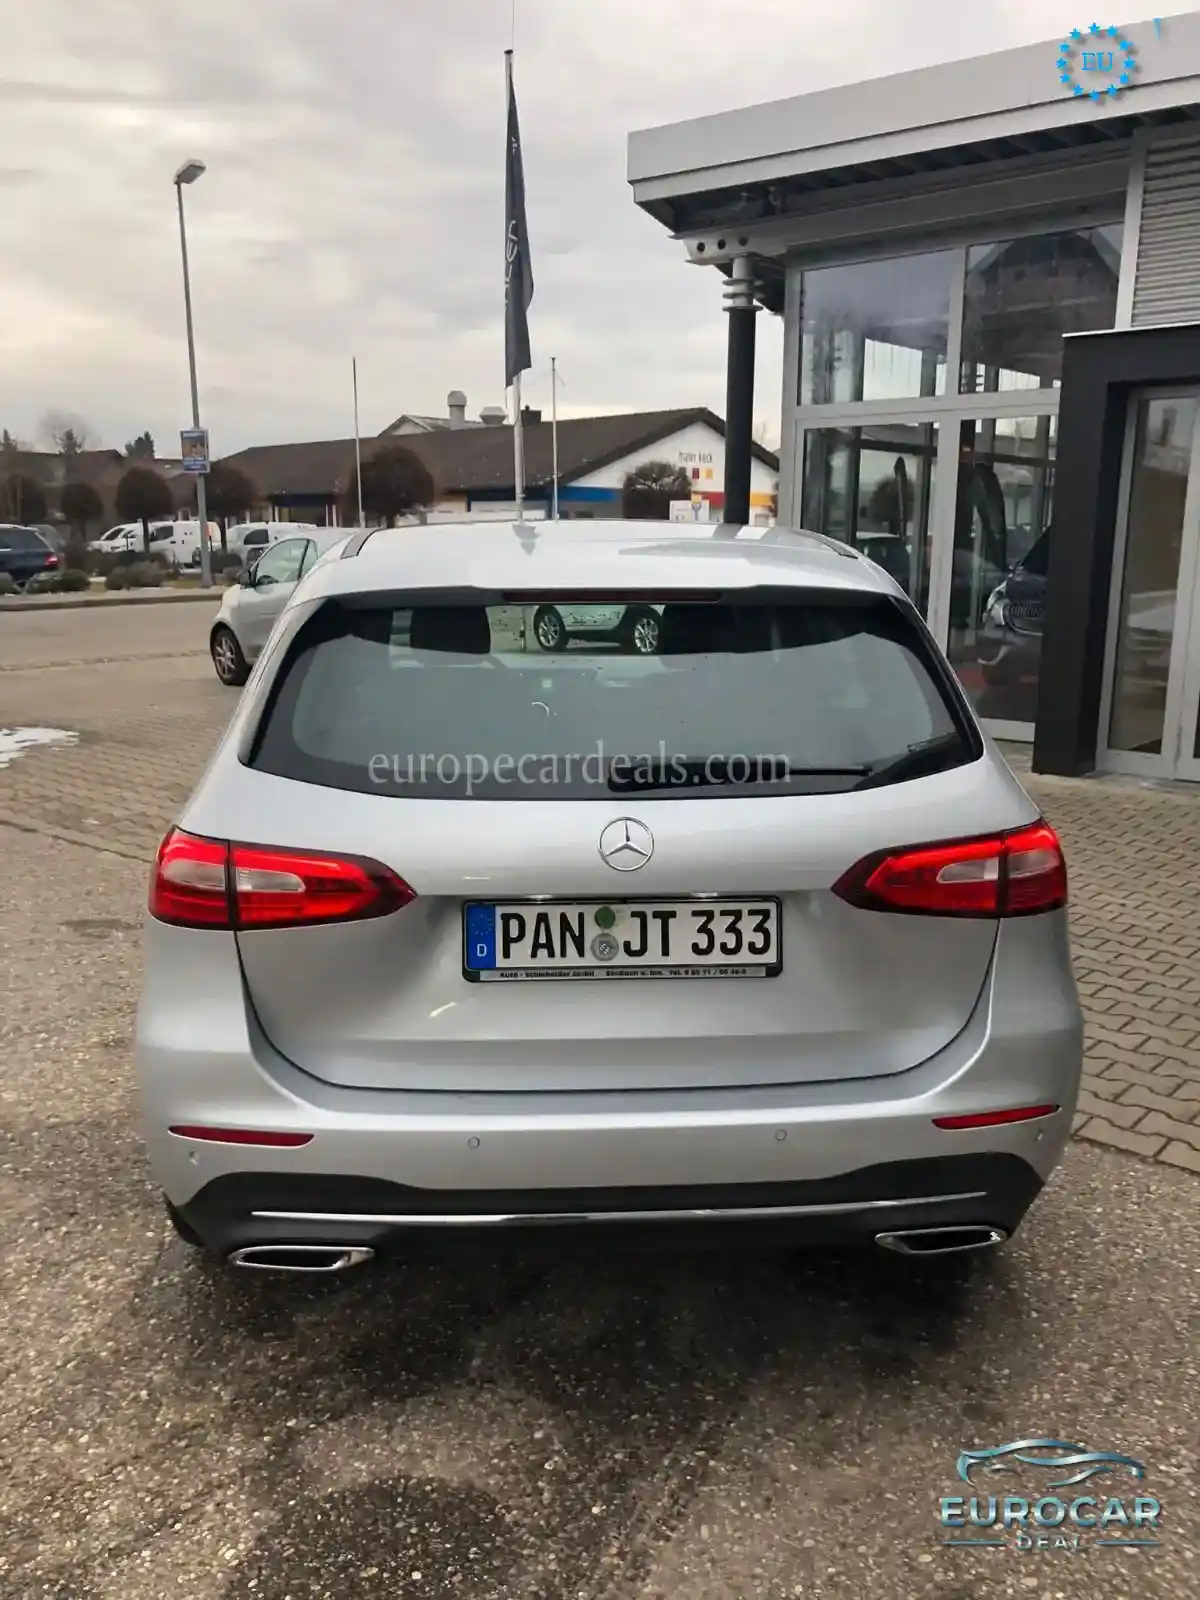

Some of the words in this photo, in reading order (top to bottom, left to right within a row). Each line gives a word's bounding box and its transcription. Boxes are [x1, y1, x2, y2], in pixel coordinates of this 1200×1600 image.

[476, 943, 487, 957] D
[499, 911, 586, 960] PAN
[622, 909, 677, 958] JT
[690, 908, 772, 957] 333
